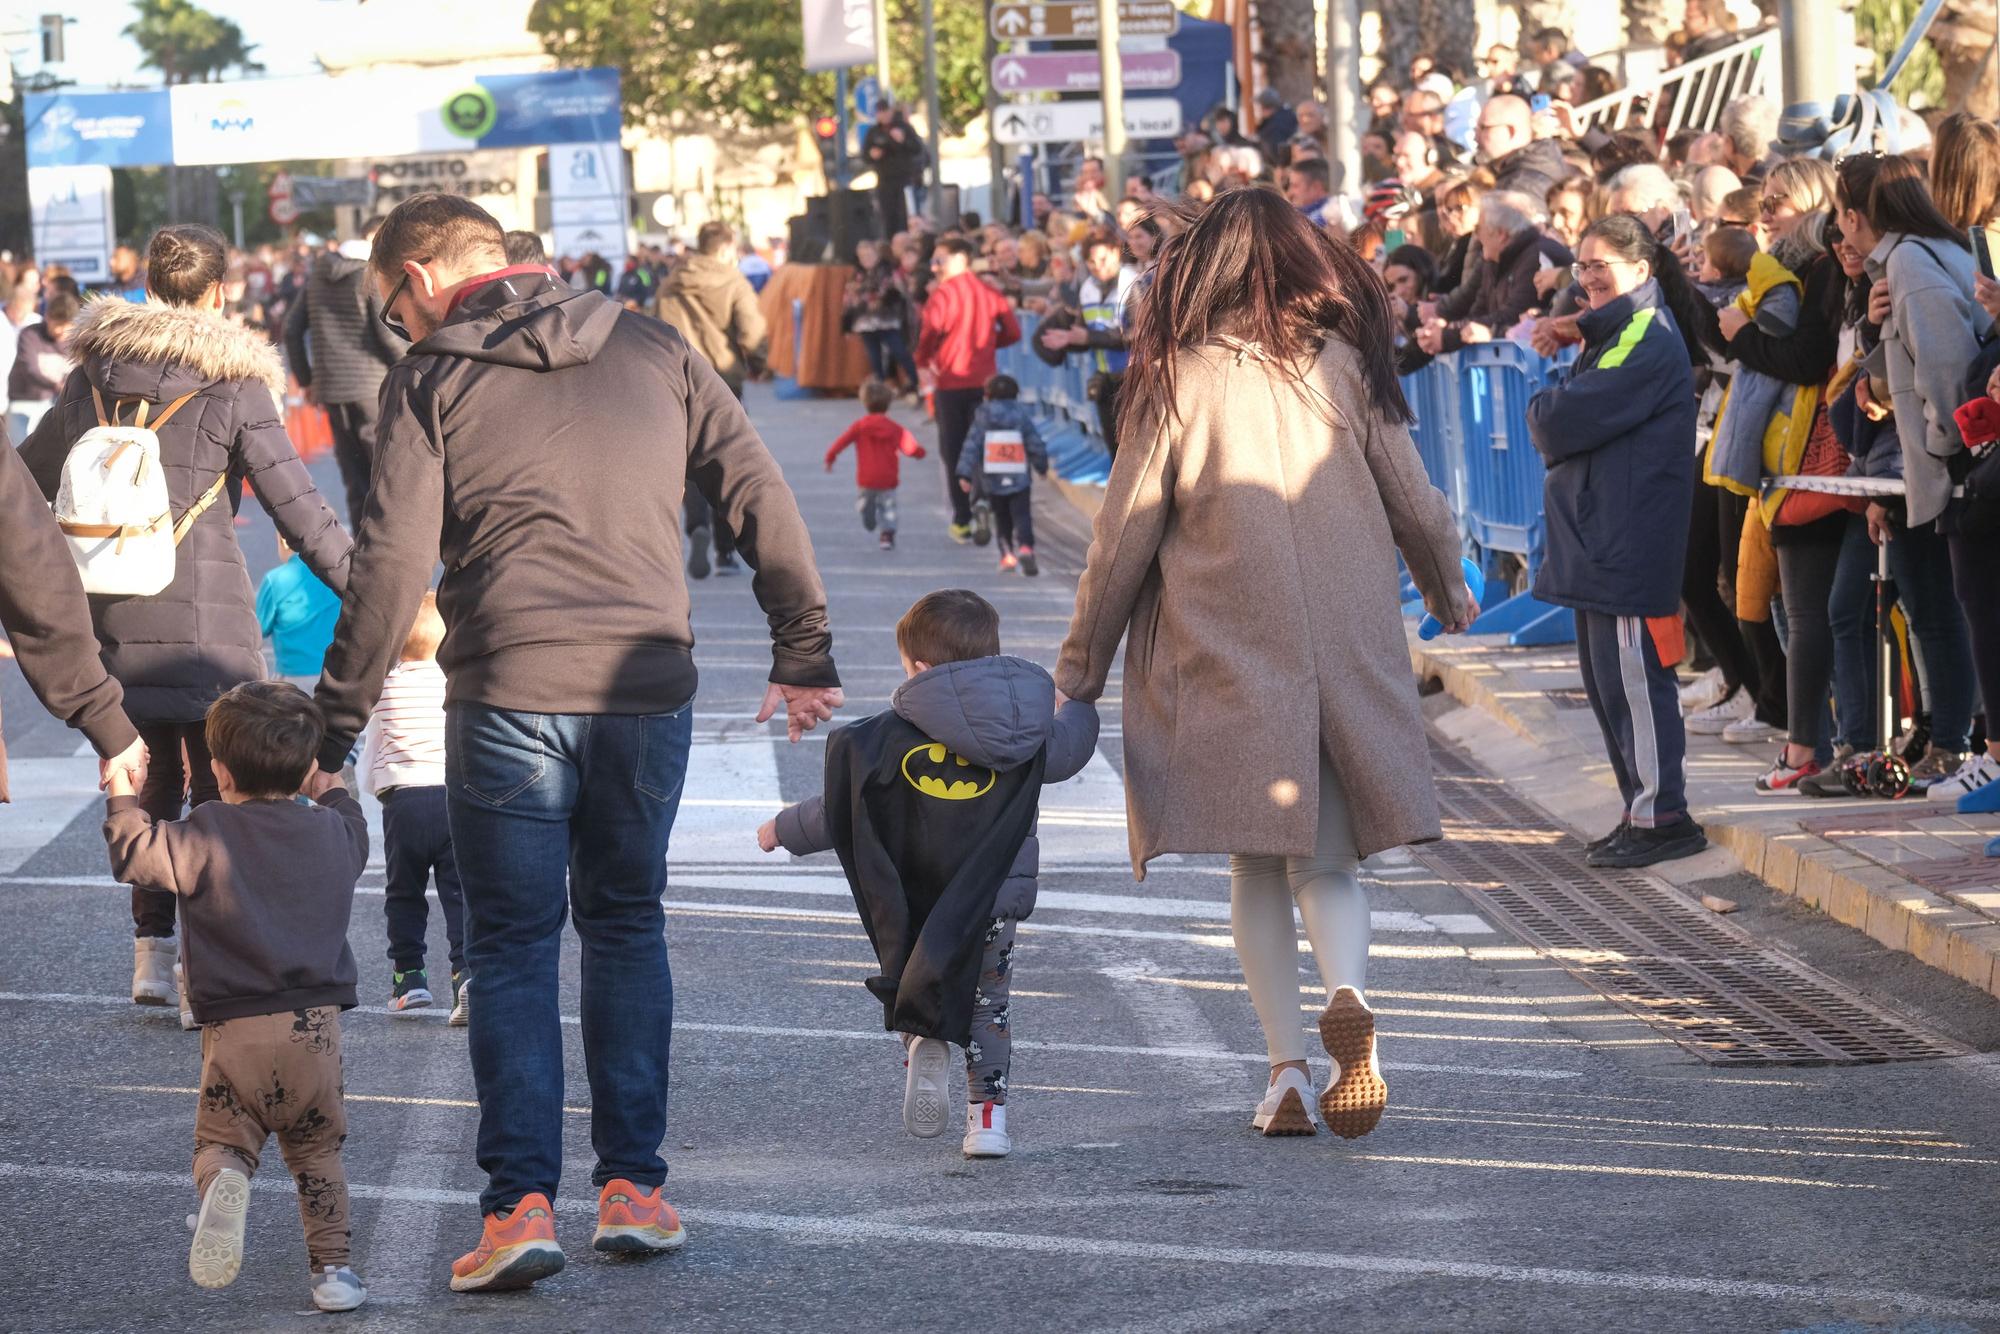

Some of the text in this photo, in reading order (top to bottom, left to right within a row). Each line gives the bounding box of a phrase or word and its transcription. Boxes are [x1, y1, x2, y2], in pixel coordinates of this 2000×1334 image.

[1121, 67, 1172, 84] unicipal
[1139, 117, 1172, 131] local
[996, 444, 1015, 461] 42
